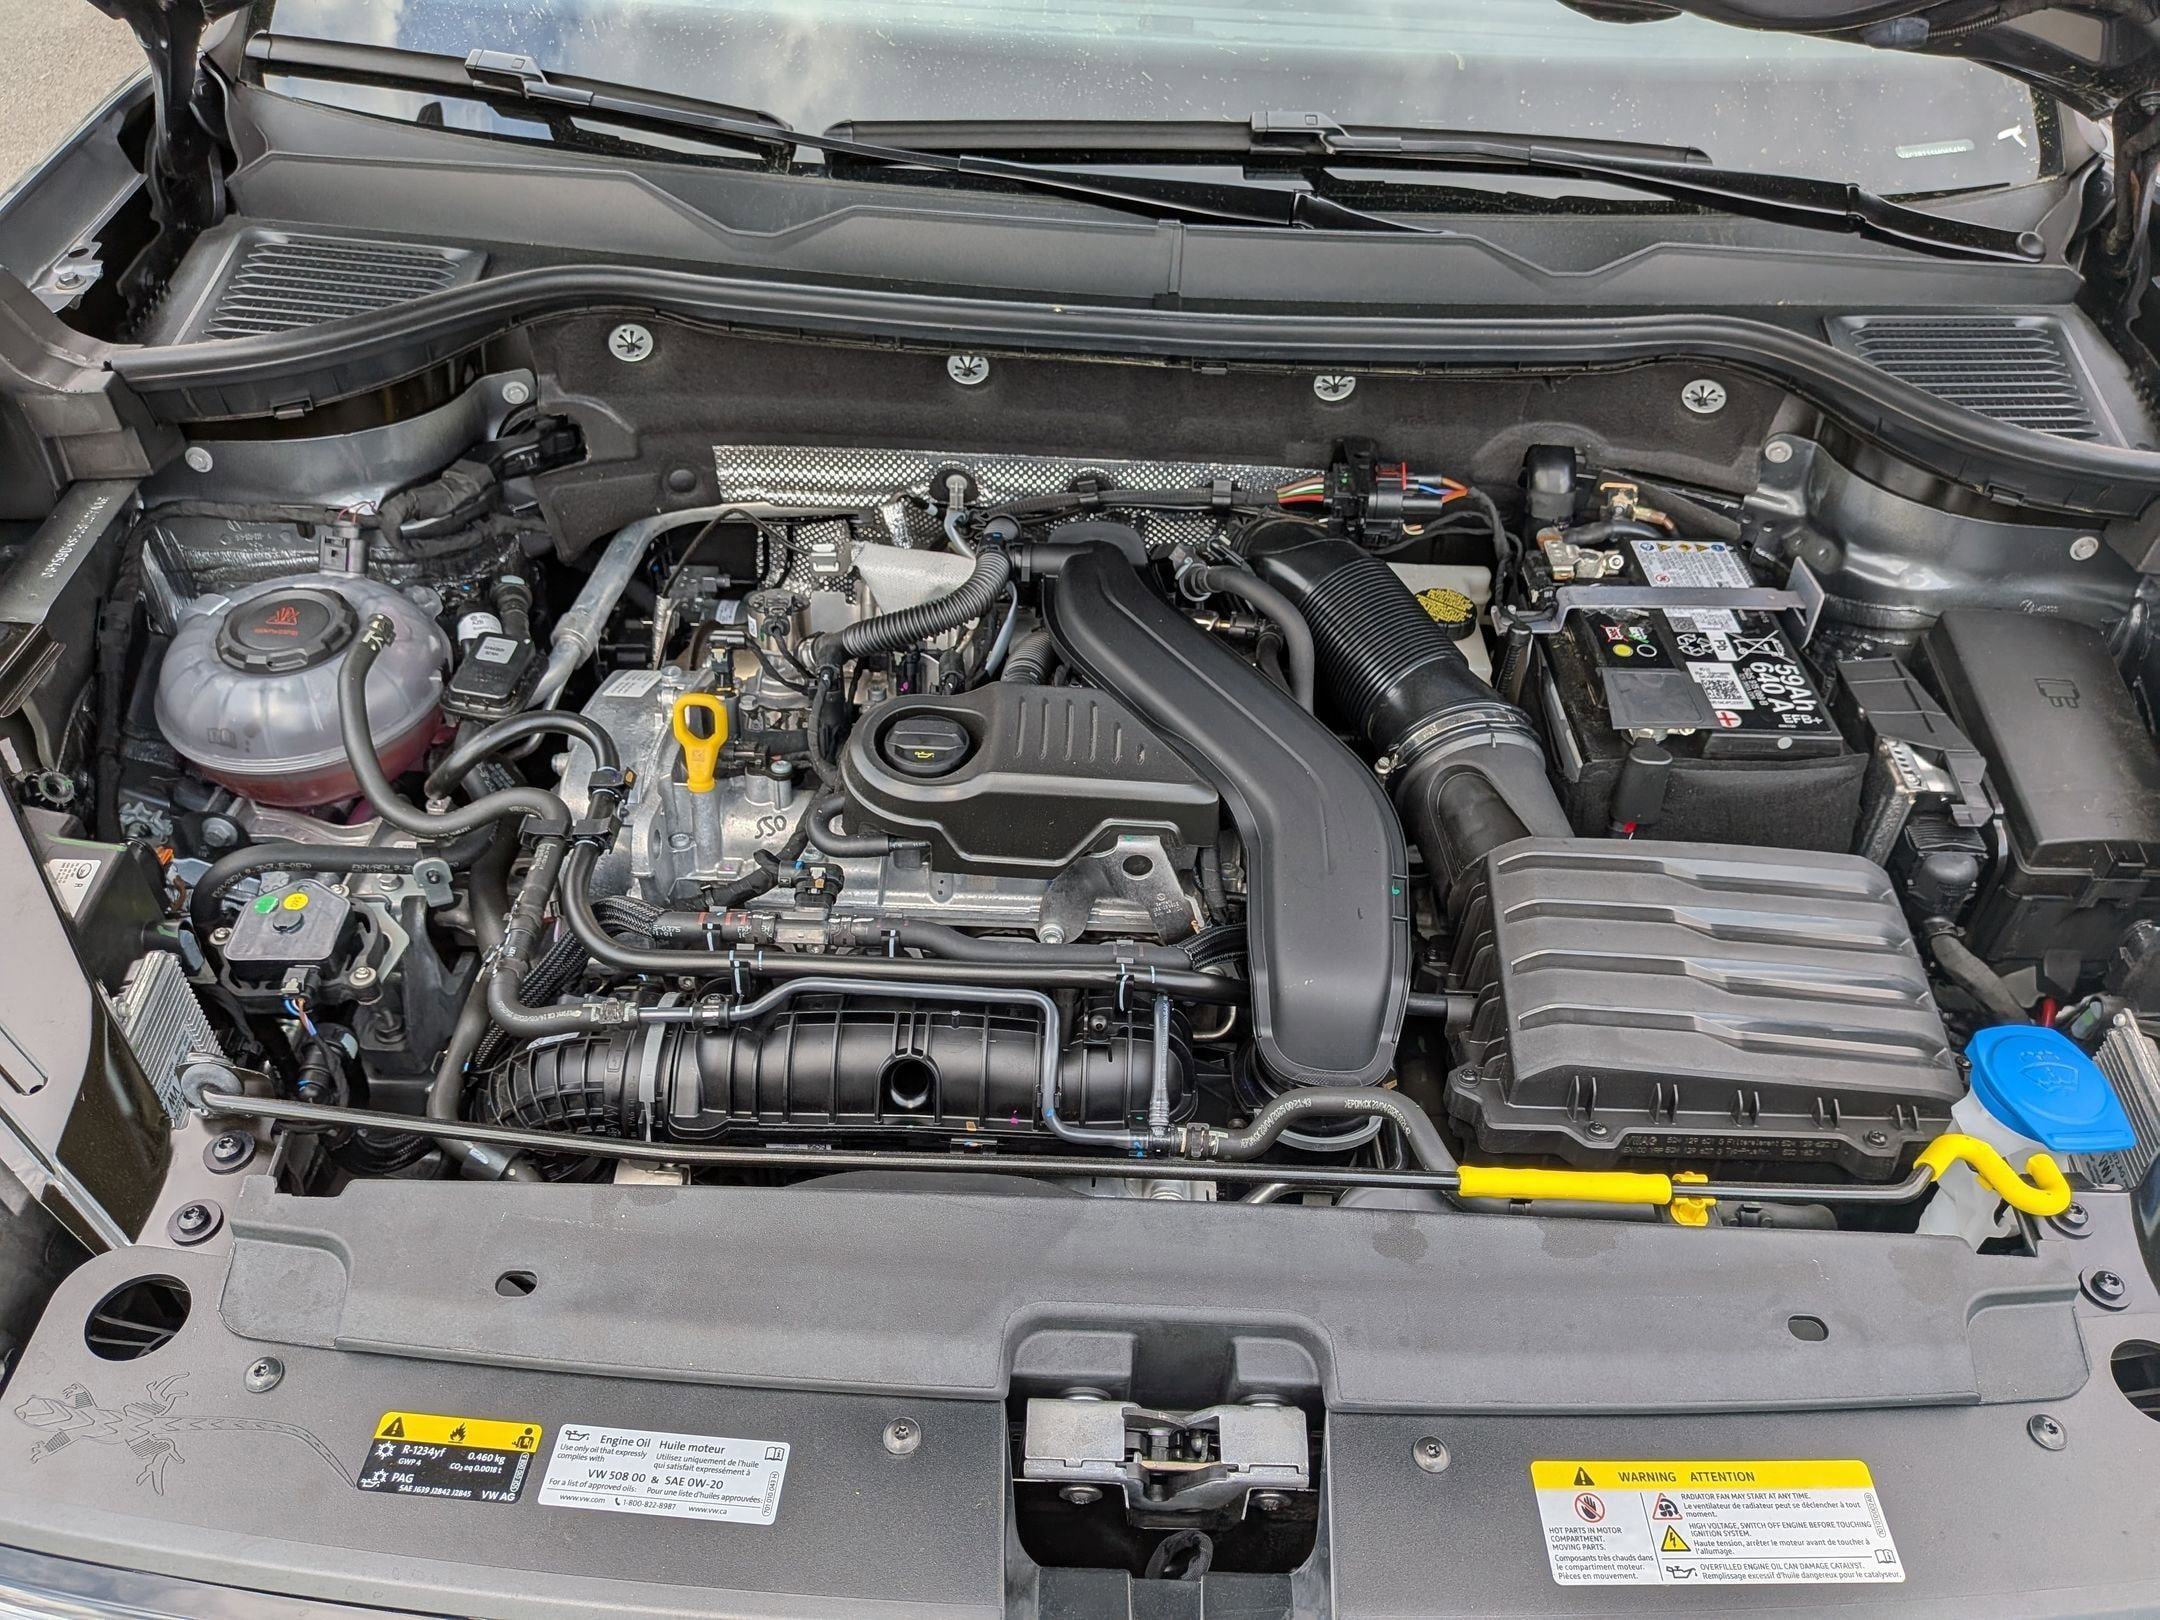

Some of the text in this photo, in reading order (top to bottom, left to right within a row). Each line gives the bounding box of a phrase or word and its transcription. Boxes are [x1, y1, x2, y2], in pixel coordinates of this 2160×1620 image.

[1714, 640, 1728, 651] Pb
[1750, 662, 1785, 694] 640
[1768, 698, 1795, 712] A
[1775, 664, 1817, 710] 59Ah
[1782, 714, 1823, 724] EFB+
[600, 1435, 651, 1447] Engine Oil
[402, 1445, 447, 1459] R-1234yf
[574, 1445, 589, 1453] only
[600, 1447, 614, 1455] that
[615, 1449, 647, 1458] expressly
[659, 1440, 725, 1454] Huile moteur
[468, 1452, 506, 1464] 0.460 kg
[557, 1453, 588, 1463] complies
[656, 1453, 759, 1468] Utilisez uniquement de l'huile
[474, 1465, 497, 1473] 0.0018
[654, 1462, 665, 1470] qui
[666, 1463, 694, 1471] satisfait
[696, 1466, 744, 1476] expressément
[391, 1472, 414, 1482] PAG
[588, 1469, 723, 1489] VW 508 00 & SAE 0W-20
[1618, 1472, 1755, 1482] WARNING ATTENTION
[413, 1486, 429, 1494] J639
[430, 1488, 450, 1496] J2842
[588, 1482, 621, 1491] approved
[622, 1484, 637, 1492] oils:
[482, 1491, 515, 1501] VW AG
[679, 1490, 693, 1498] liste
[694, 1491, 720, 1500] d'huiles
[721, 1494, 763, 1504] approuvées:
[560, 1495, 727, 1514] www.vw.com 1-800-822-8987 www.vw.ca
[1696, 1548, 1734, 1556] l'allumage.
[1565, 1563, 1615, 1571] compartiment
[1801, 1572, 1836, 1580] dangereux
[1864, 1571, 1902, 1579] catalyseur.
